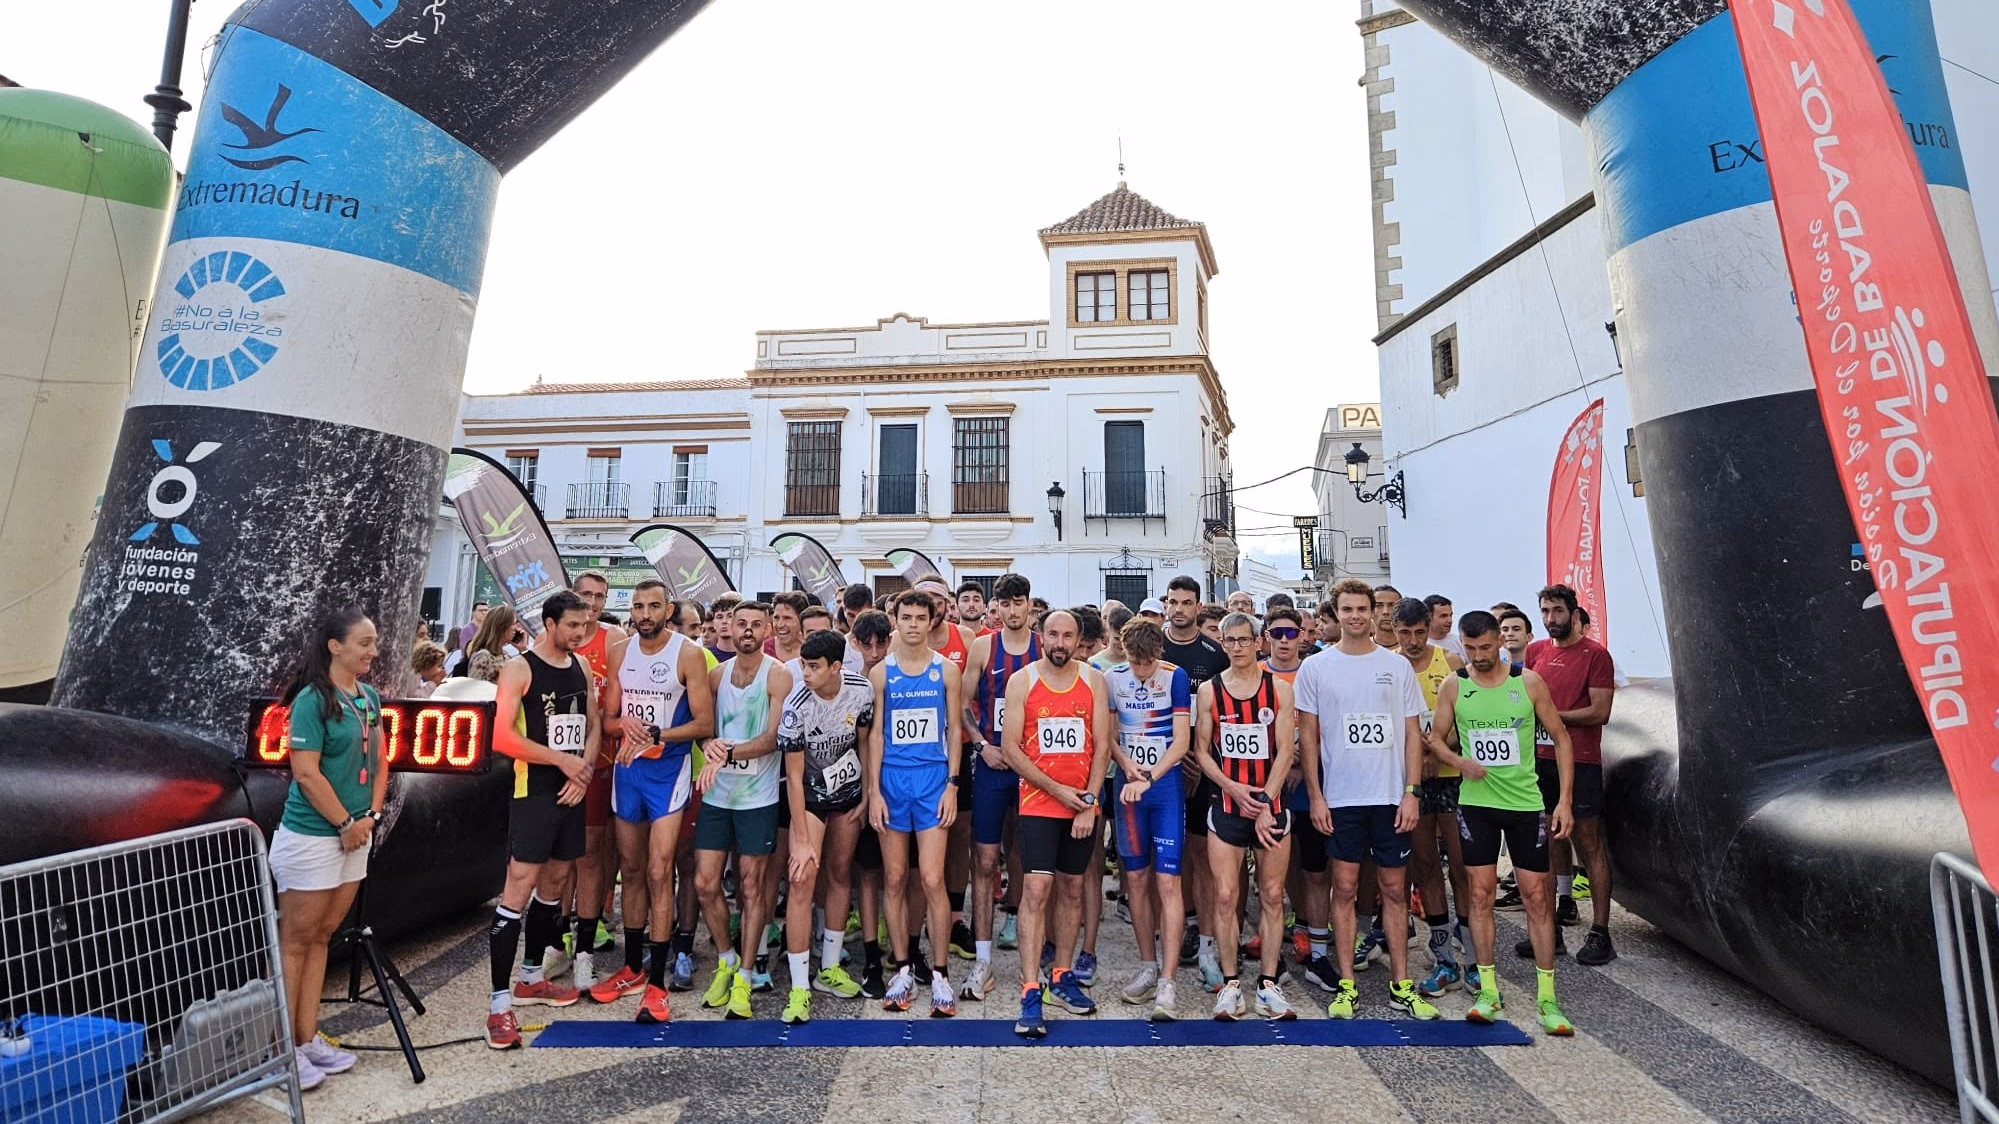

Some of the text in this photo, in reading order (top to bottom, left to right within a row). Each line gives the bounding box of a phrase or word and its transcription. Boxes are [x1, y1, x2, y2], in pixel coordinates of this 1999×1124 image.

[178, 180, 361, 220] Extremadura
[175, 304, 260, 321] #No a la
[160, 318, 283, 337] Basuraleza
[125, 544, 199, 564] fundación
[118, 560, 196, 580] jóvenes
[116, 578, 191, 596] y deporte
[905, 689, 938, 698] OLIVENZA
[627, 702, 655, 724] 893
[1125, 701, 1155, 710] MASERO
[896, 718, 929, 740] 807
[1348, 723, 1385, 744] 823
[1468, 719, 1508, 729] Texla
[554, 724, 581, 746] 878
[808, 731, 856, 751] Emirates
[1043, 727, 1077, 749] 946
[1225, 733, 1260, 755] 965
[1127, 744, 1158, 766] 796
[1475, 739, 1511, 761] 899
[829, 761, 857, 790] 793
